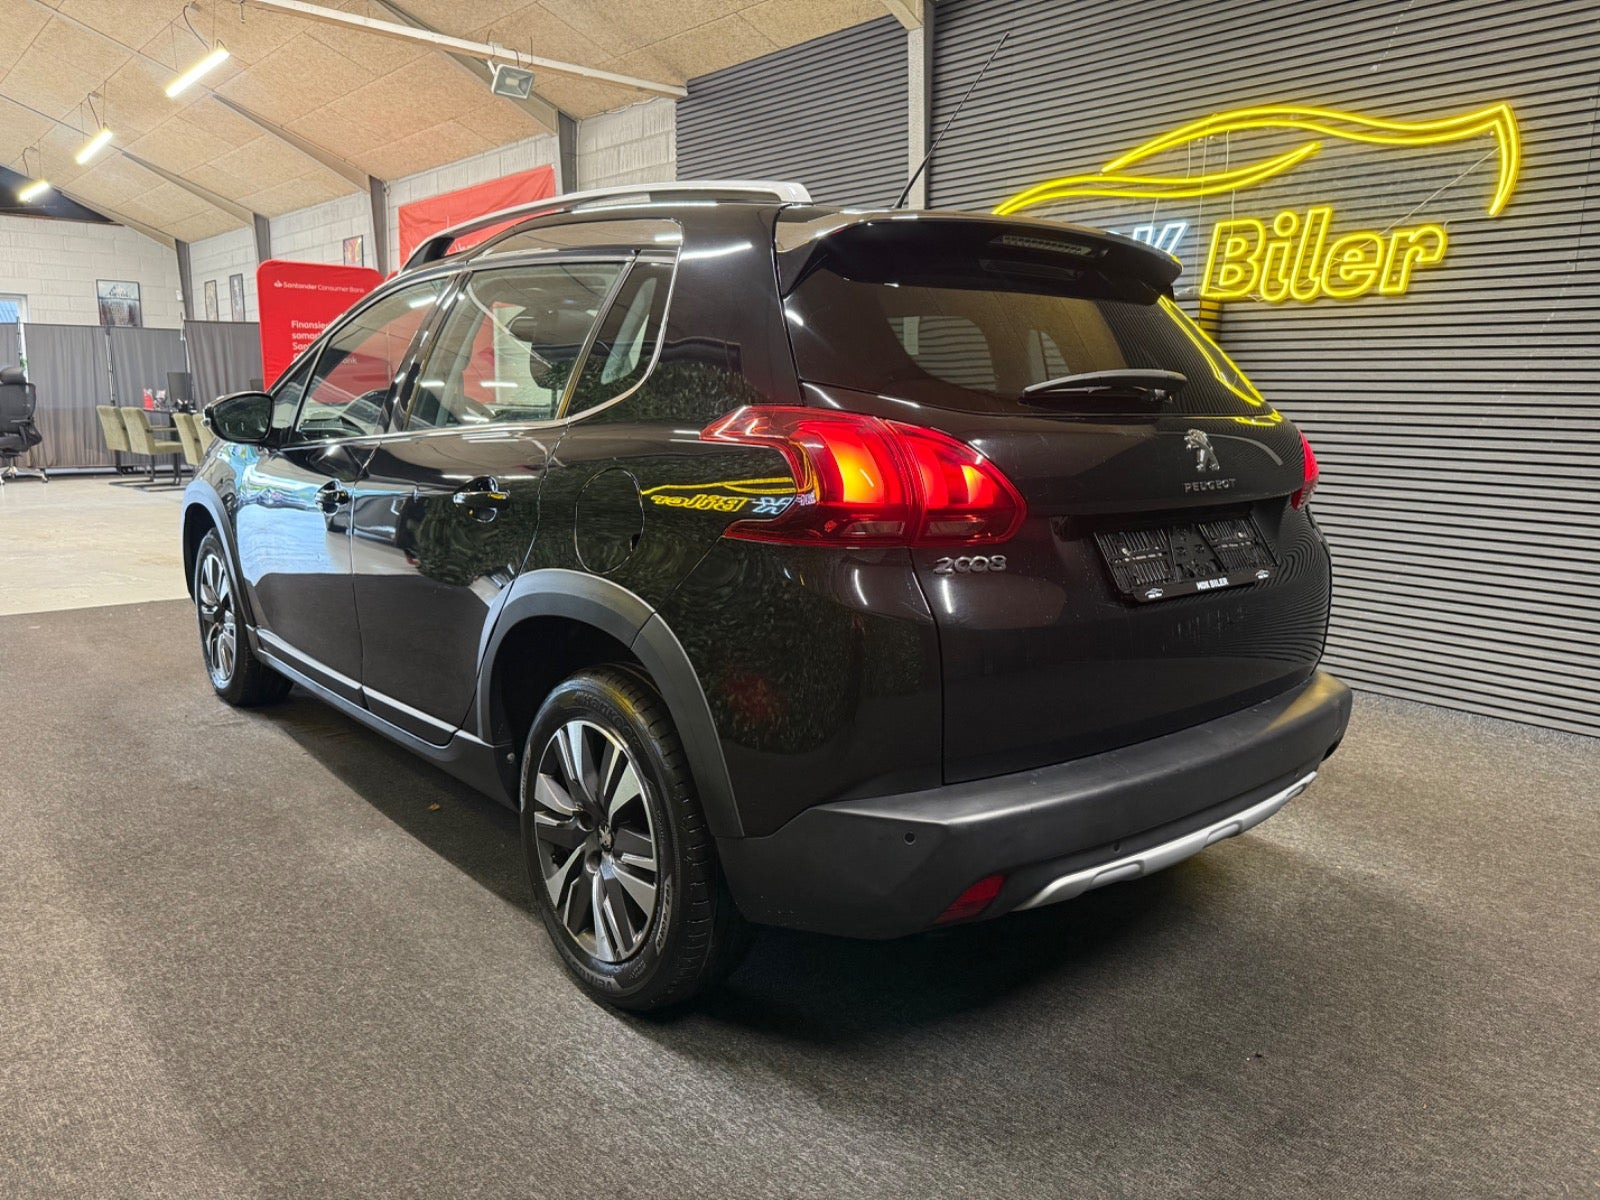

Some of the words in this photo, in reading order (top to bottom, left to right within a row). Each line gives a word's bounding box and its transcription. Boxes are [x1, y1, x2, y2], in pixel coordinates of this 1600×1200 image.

[1200, 207, 1448, 301] Biler
[283, 281, 316, 290] Santander
[318, 284, 348, 293] Consumer
[1183, 478, 1237, 493] PEUGEOT
[933, 554, 1007, 574] 2008
